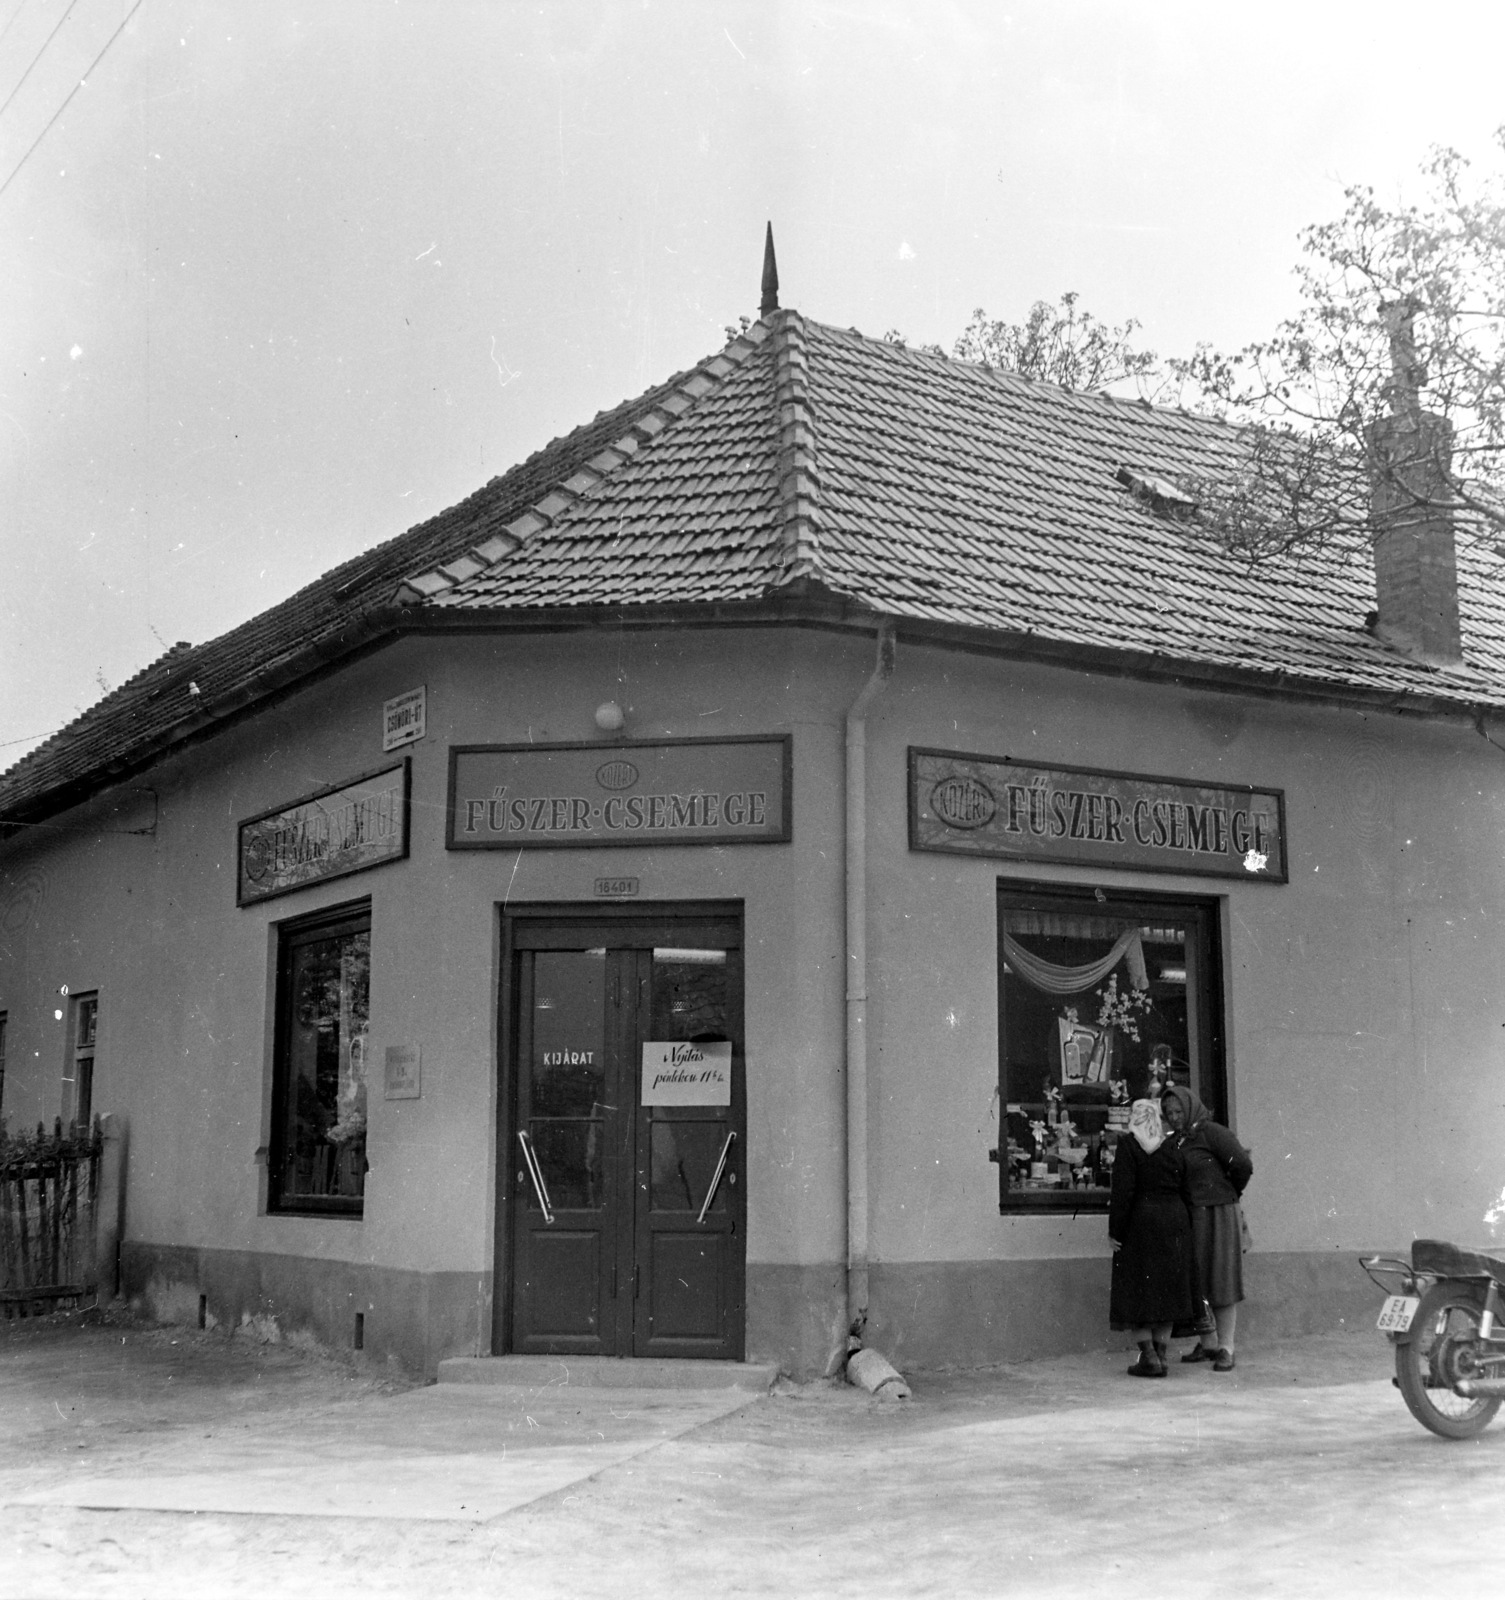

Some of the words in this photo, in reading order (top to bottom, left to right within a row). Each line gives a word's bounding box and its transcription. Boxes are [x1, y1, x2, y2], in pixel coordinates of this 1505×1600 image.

[598, 881, 632, 893] 16401
[543, 1045, 594, 1066] KIJÁRAT
[663, 1044, 704, 1067] Nyitás
[1391, 1299, 1406, 1312] EA
